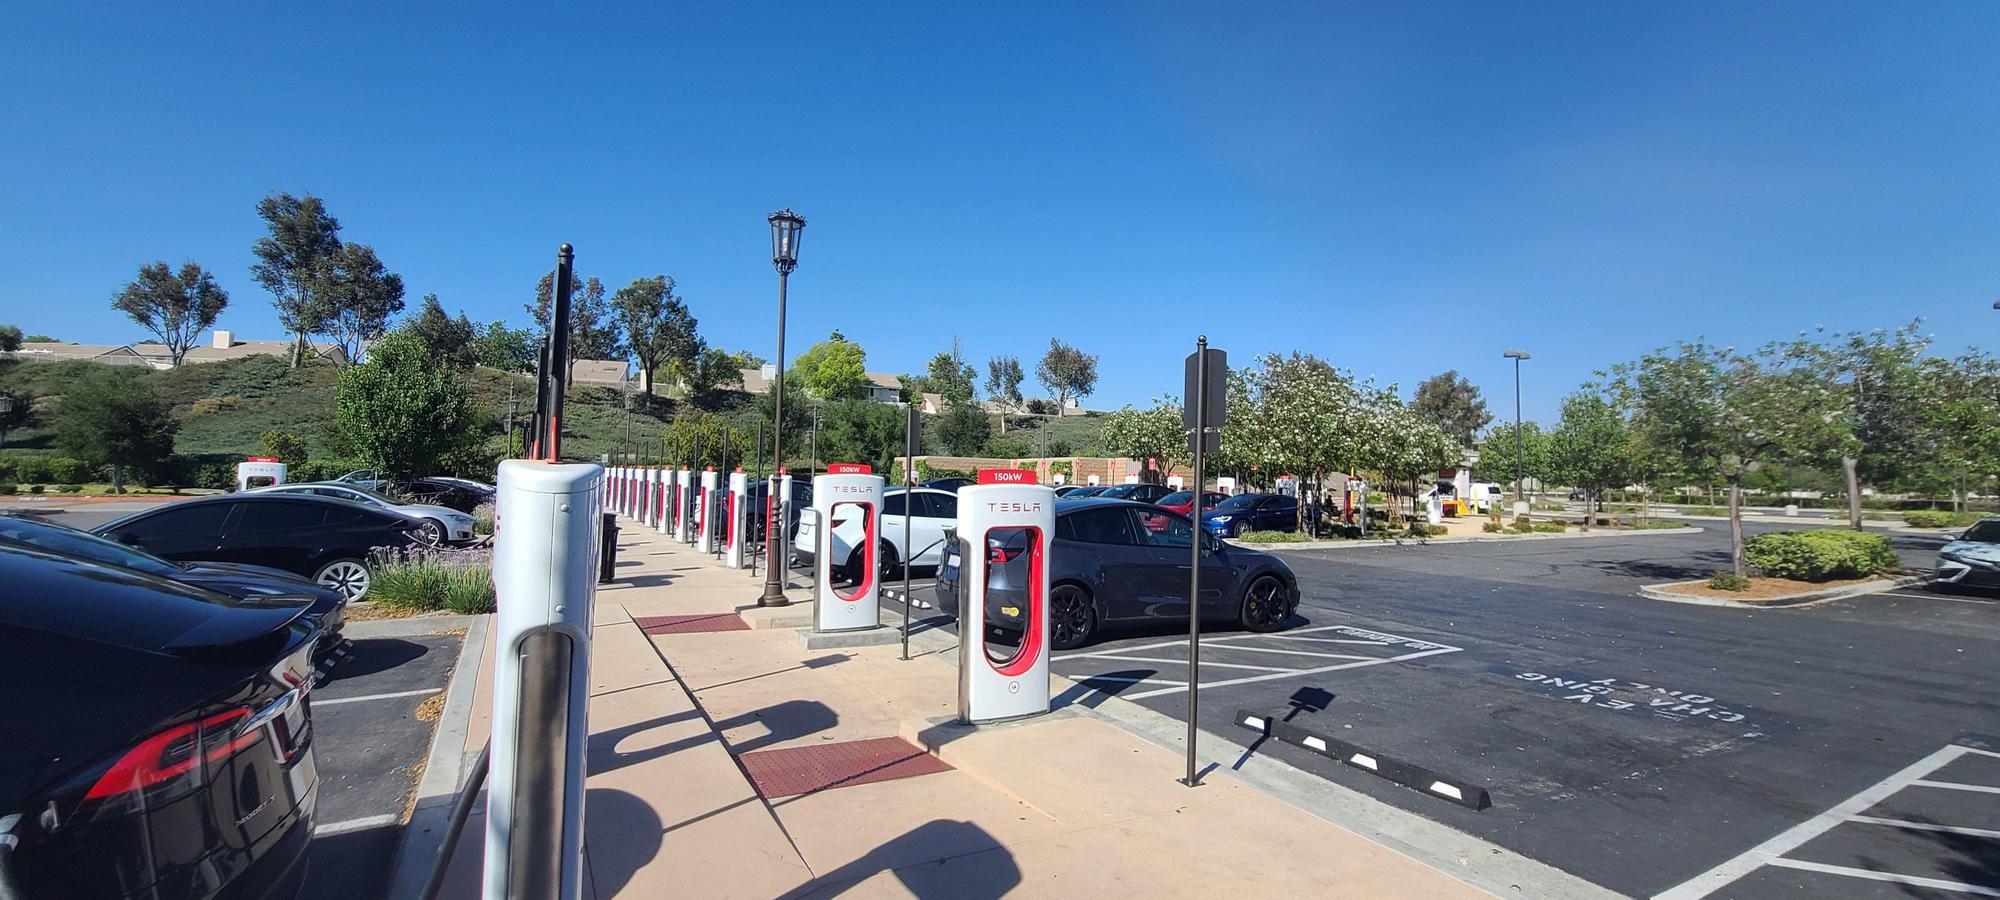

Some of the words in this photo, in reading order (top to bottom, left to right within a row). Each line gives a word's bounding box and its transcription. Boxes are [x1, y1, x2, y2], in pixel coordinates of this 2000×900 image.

[993, 472, 1023, 481] 150kW
[987, 503, 1041, 512] TESLA
[1515, 672, 1745, 722] CHAGING
[1563, 694, 1635, 710] EV
